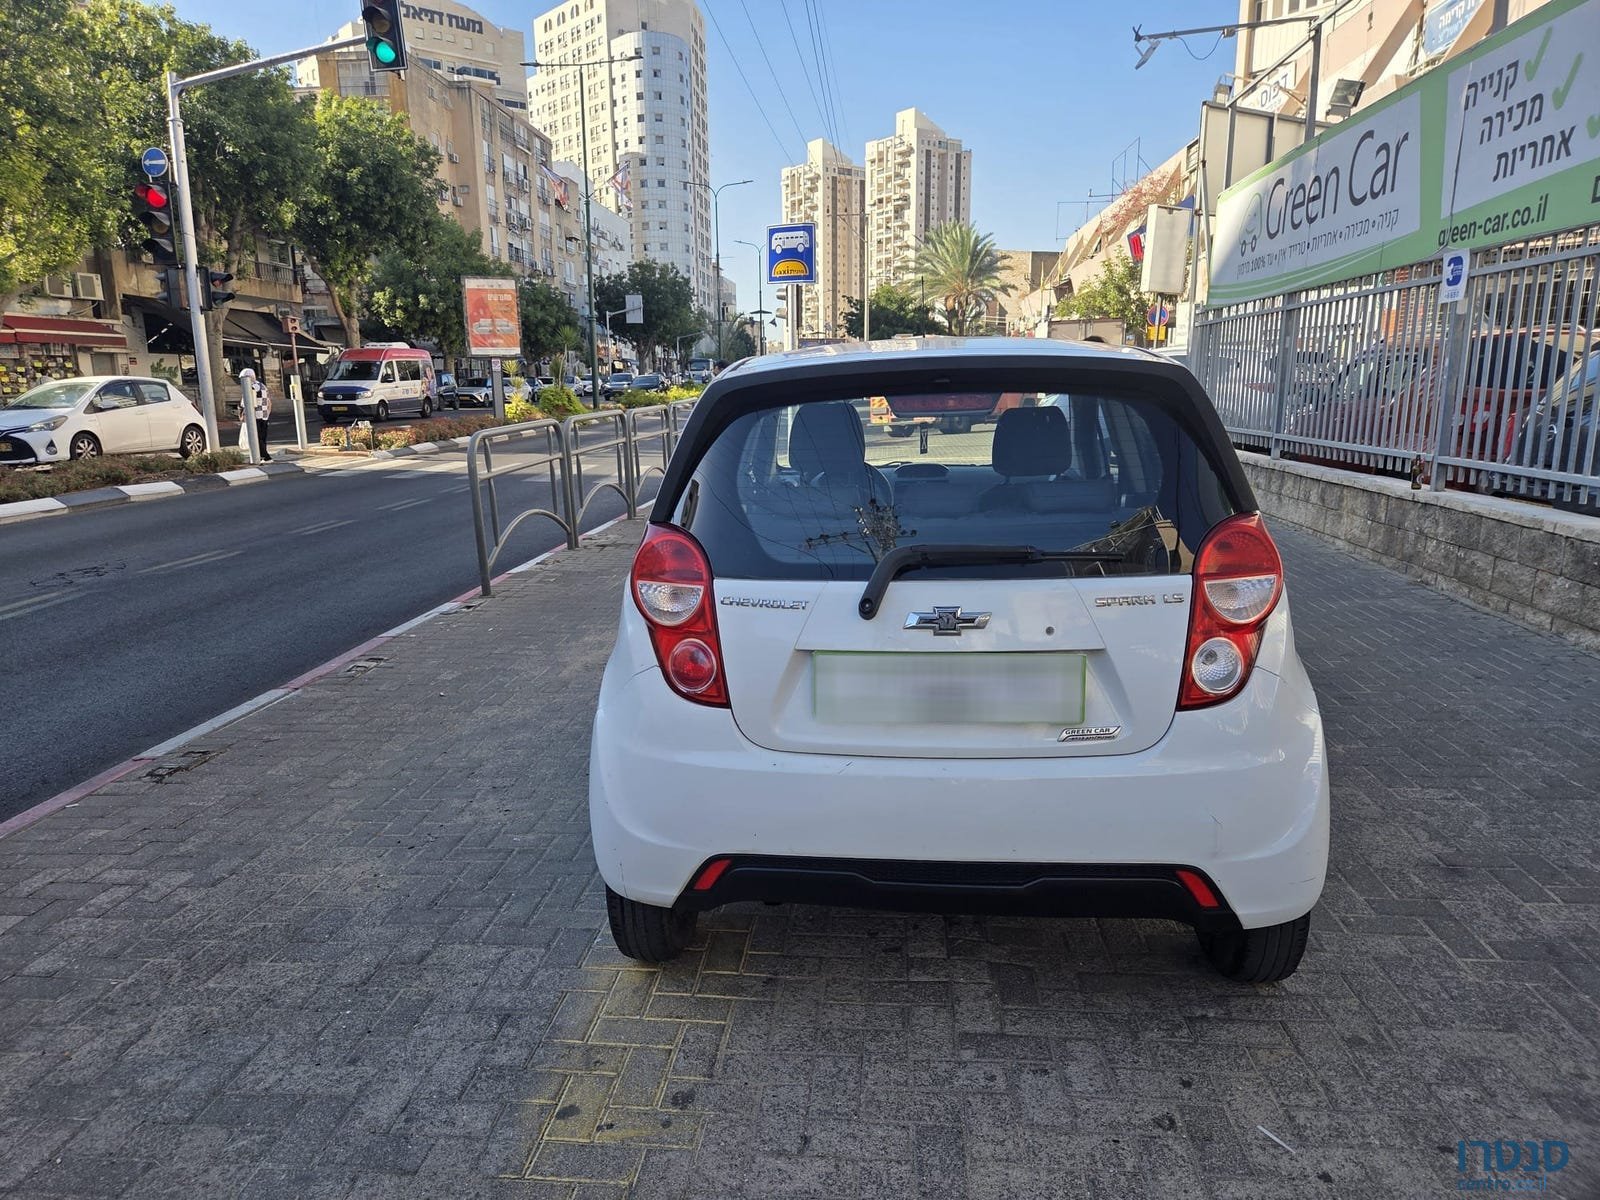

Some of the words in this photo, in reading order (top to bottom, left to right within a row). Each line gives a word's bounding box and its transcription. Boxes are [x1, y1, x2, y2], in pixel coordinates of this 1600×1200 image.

[1464, 60, 1520, 111] קנייה
[1479, 93, 1544, 145] מכירה
[1492, 125, 1577, 182] אחריות
[1266, 165, 1340, 240] Green
[1348, 129, 1410, 206] Car
[1344, 219, 1369, 241] מכירה
[1376, 208, 1399, 232] קניה
[1311, 230, 1337, 252] אחריות
[720, 596, 808, 610] CHEVROLET
[1095, 595, 1156, 607] SPARK
[1163, 593, 1184, 604] LS
